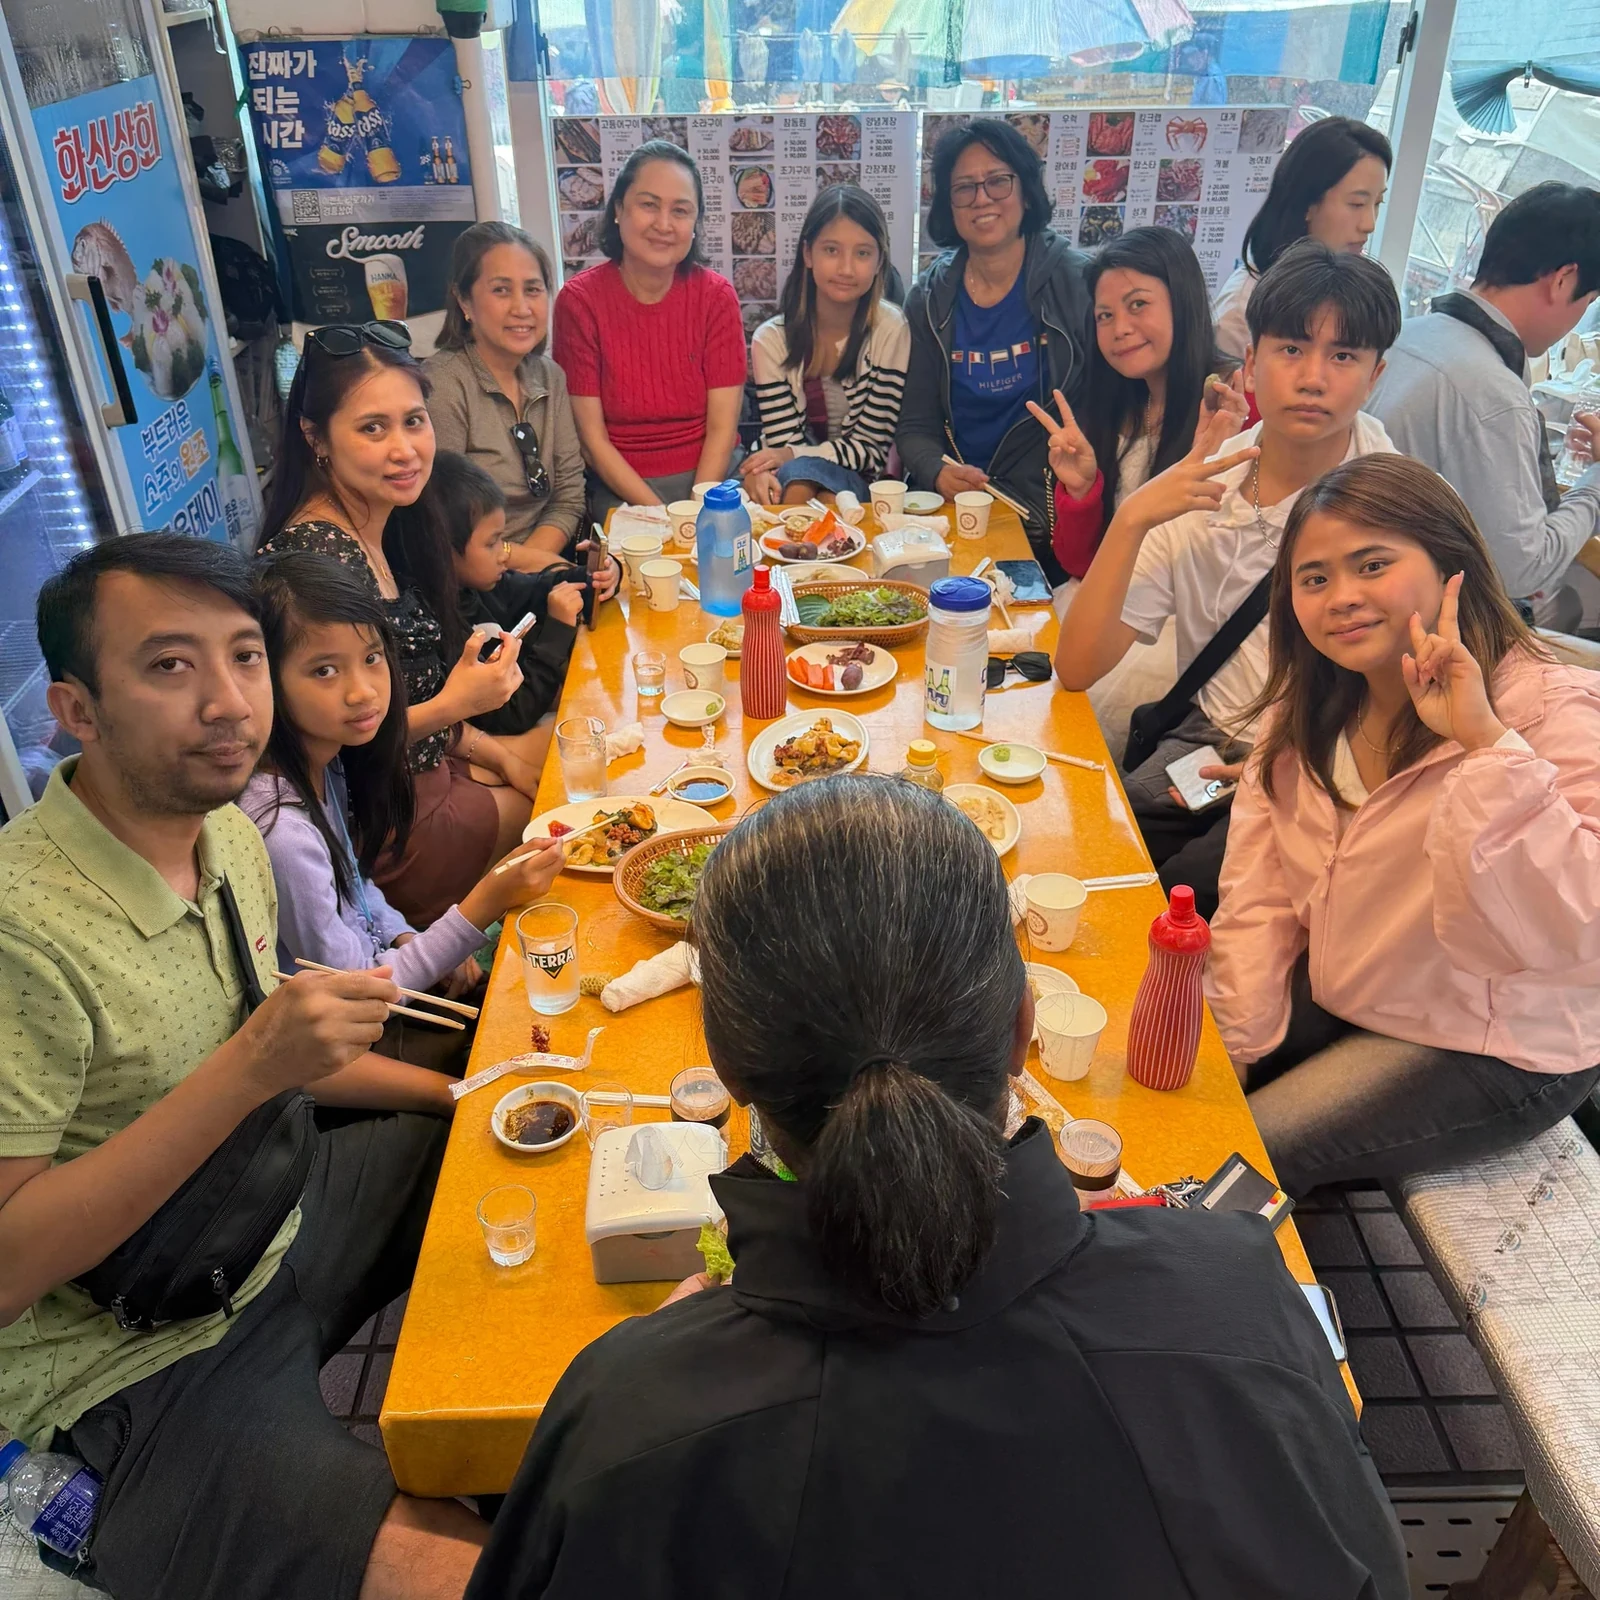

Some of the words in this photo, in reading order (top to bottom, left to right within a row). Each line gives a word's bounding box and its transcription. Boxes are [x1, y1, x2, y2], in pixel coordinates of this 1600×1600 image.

[249, 50, 317, 80] 진짜가
[253, 86, 299, 114] 되는
[866, 116, 897, 126] 양념게장
[1062, 114, 1077, 123] 우럭
[1139, 113, 1162, 122] 킹크랩
[1221, 112, 1236, 121] 대게
[601, 119, 640, 129] 고등어구이
[691, 118, 723, 128] 소라구이
[263, 120, 305, 148] 시간
[865, 164, 896, 174] 간장게장
[1055, 162, 1077, 171] 광어회
[1133, 160, 1156, 170] 랍스타
[1214, 160, 1229, 168] 개불
[702, 167, 716, 175] 조개
[780, 166, 811, 175] 조기구이
[326, 225, 425, 259] Smooth
[979, 373, 1023, 389] HILFIGER
[142, 400, 192, 462] 부드러운
[144, 457, 187, 516] 소주의
[180, 428, 210, 481] 원조
[161, 478, 222, 537] 은데이
[528, 947, 575, 969] TERRA
[42, 1489, 73, 1521] 먹는샘물
[62, 1497, 84, 1522] 청주시
